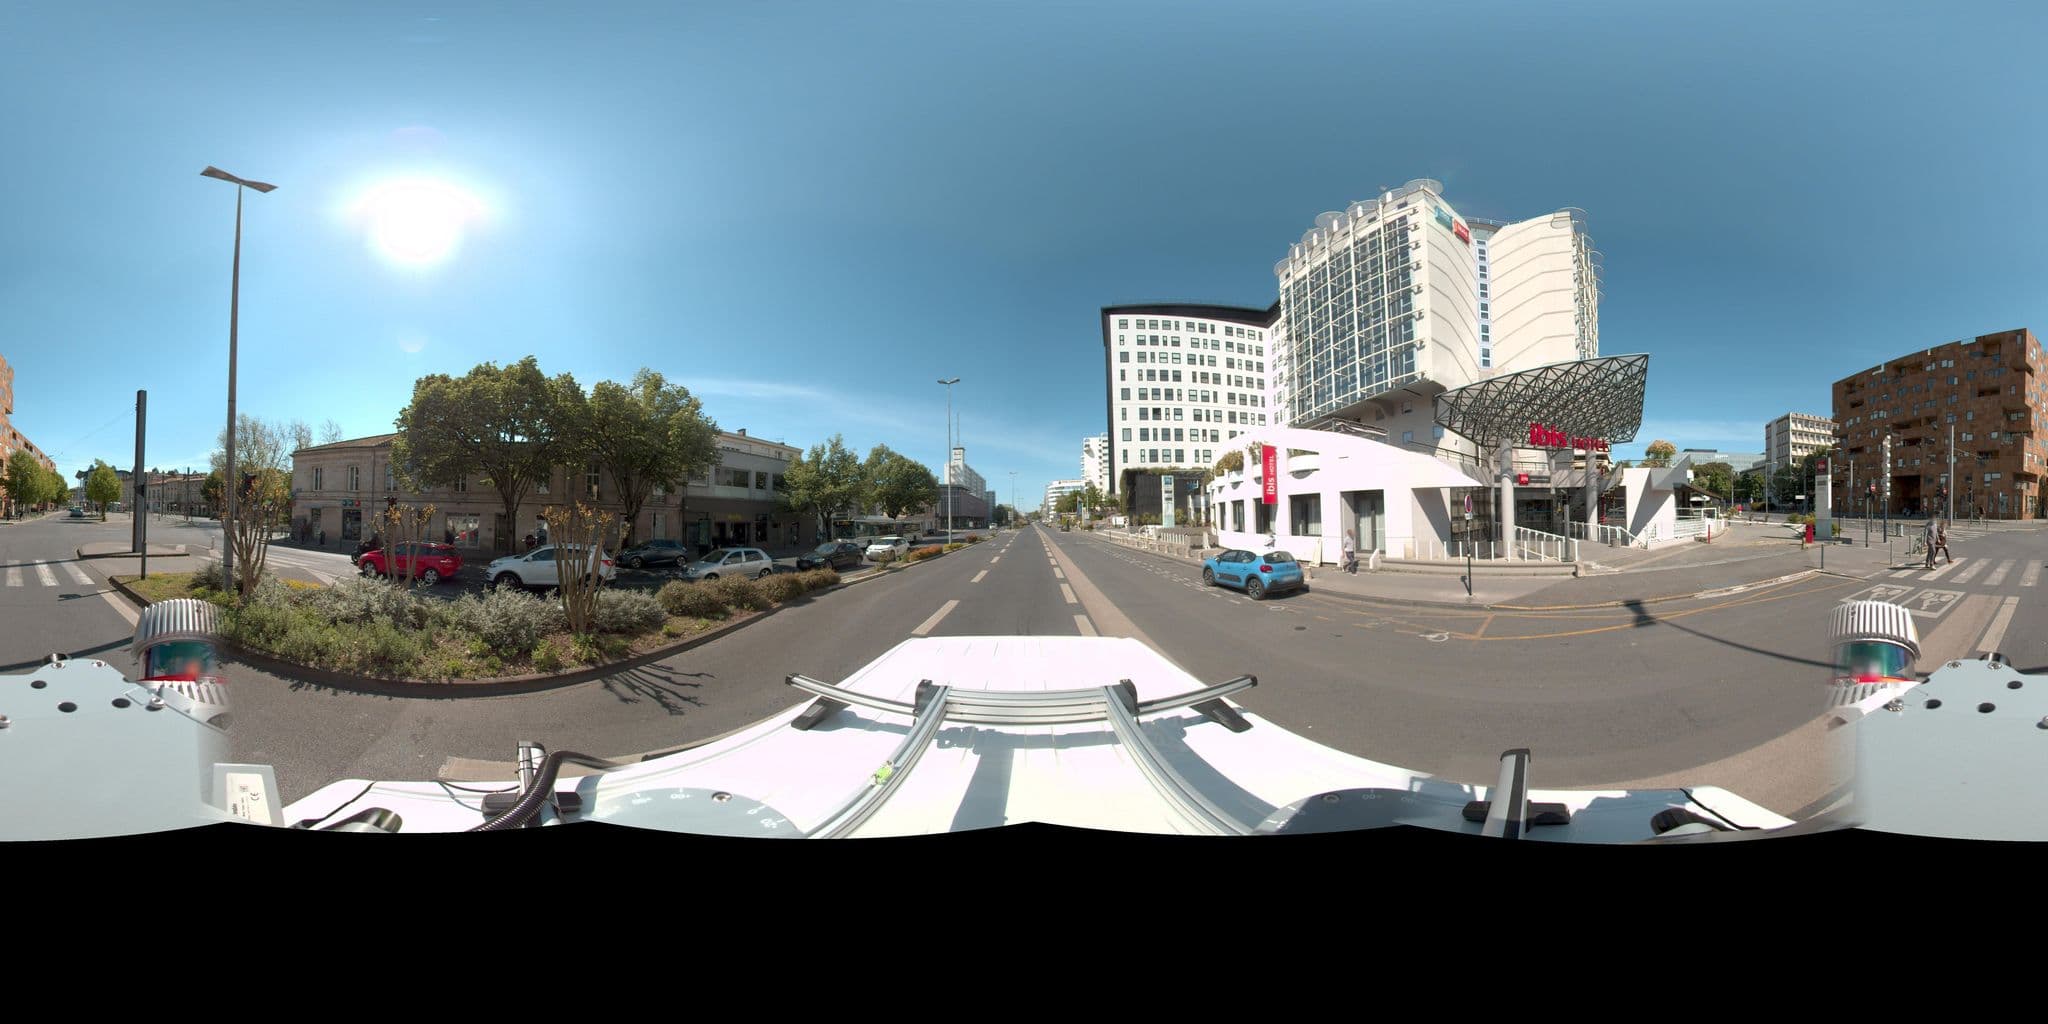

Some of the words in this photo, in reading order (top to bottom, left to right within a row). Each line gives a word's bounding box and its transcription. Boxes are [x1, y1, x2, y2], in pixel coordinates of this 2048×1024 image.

[1529, 422, 1567, 448] ibis
[1571, 435, 1609, 452] HOTEL
[1266, 477, 1275, 495] ibis
